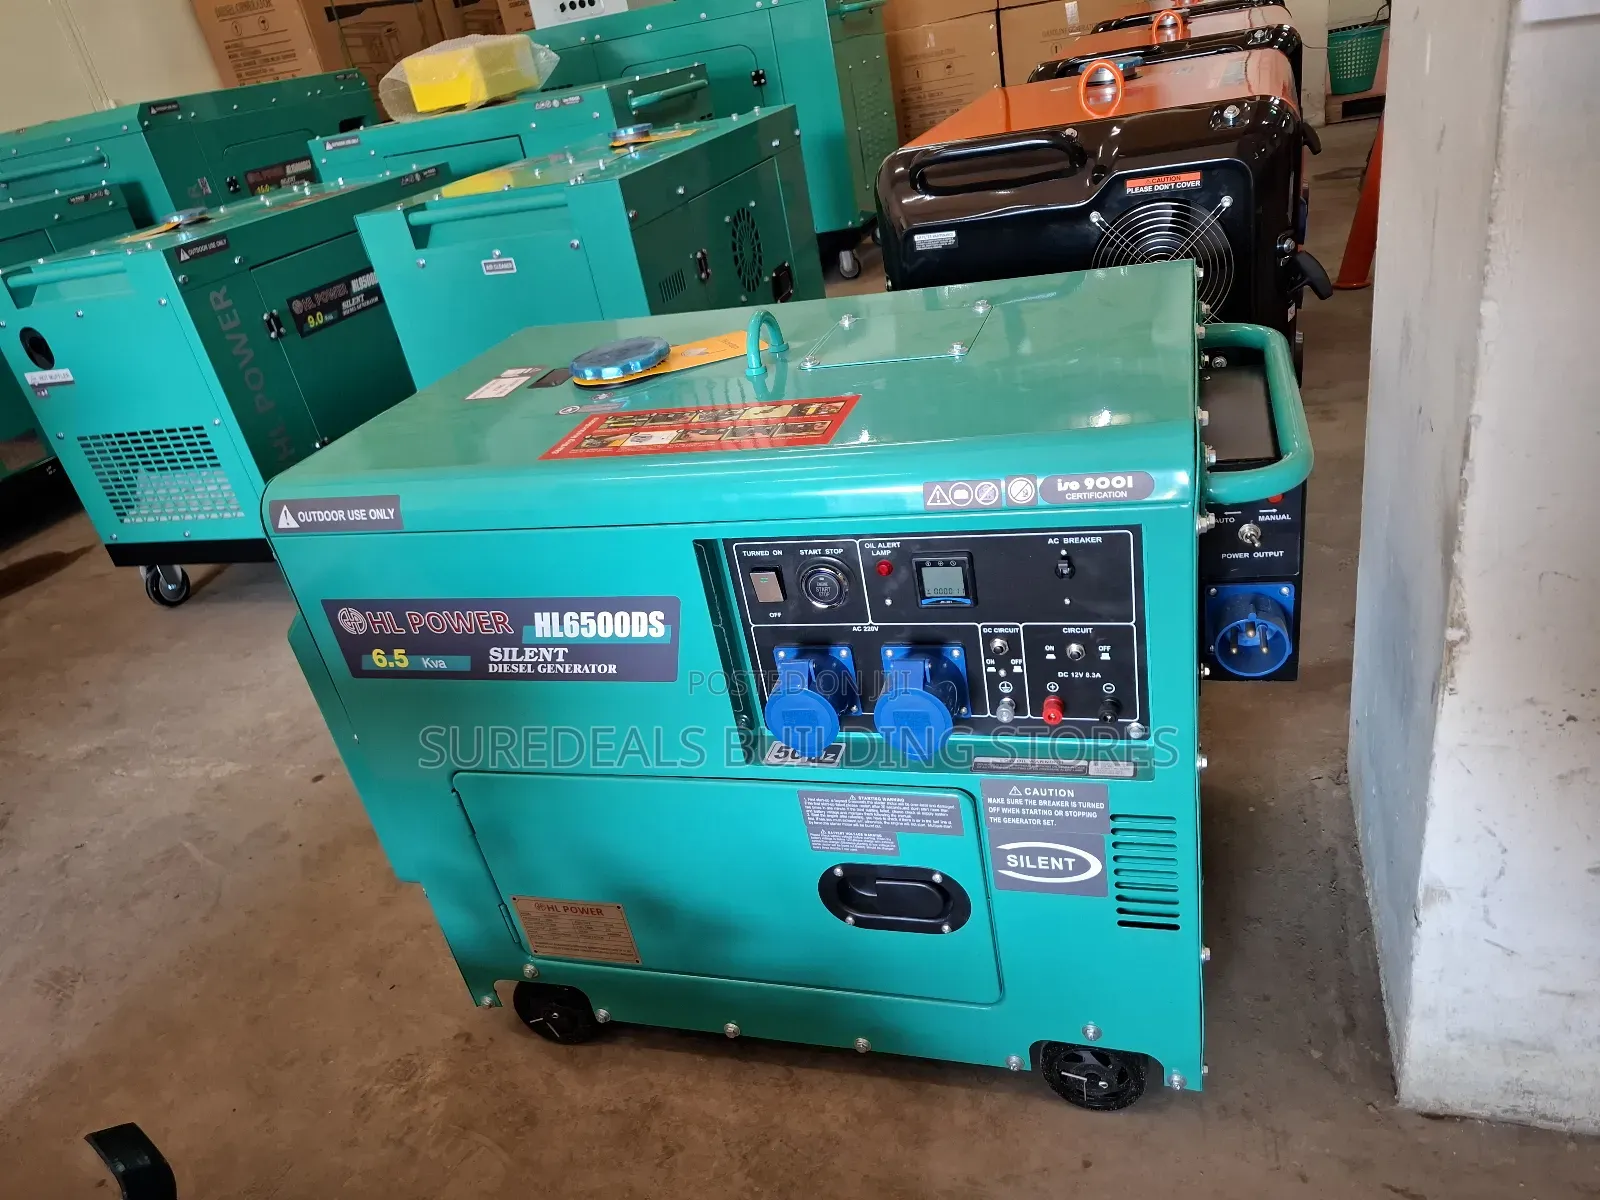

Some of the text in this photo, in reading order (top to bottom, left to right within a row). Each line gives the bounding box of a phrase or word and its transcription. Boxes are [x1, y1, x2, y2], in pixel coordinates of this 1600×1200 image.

[1151, 175, 1181, 184] CAUTION
[1126, 180, 1200, 194] PLEASE DON'T COVER
[308, 311, 324, 328] 9.0
[209, 285, 276, 414] POWER
[1084, 475, 1134, 491] 9001
[1065, 490, 1128, 501] CERTIFICATION
[298, 508, 395, 523] OUTDOOR USE ONLY
[1214, 514, 1292, 524] AUTO MANUAL
[878, 541, 901, 549] ALERT
[1047, 536, 1102, 545] AC BREAKER
[1221, 550, 1284, 560] POWER OUTPUT
[366, 610, 515, 636] HL POWER
[534, 610, 666, 639] HL6500DS
[372, 648, 448, 670] 6.5 Kva
[488, 646, 569, 662] SILENT
[488, 663, 618, 674] DIESEL GENERATOR
[1024, 787, 1074, 798] CAUTION
[1024, 798, 1037, 806] THE
[1022, 808, 1052, 816] STARTING
[1064, 810, 1098, 818] STOPPING
[1003, 817, 1042, 825] GENERATOR
[1006, 854, 1076, 871] SILENT
[546, 905, 604, 916] HL POWER
